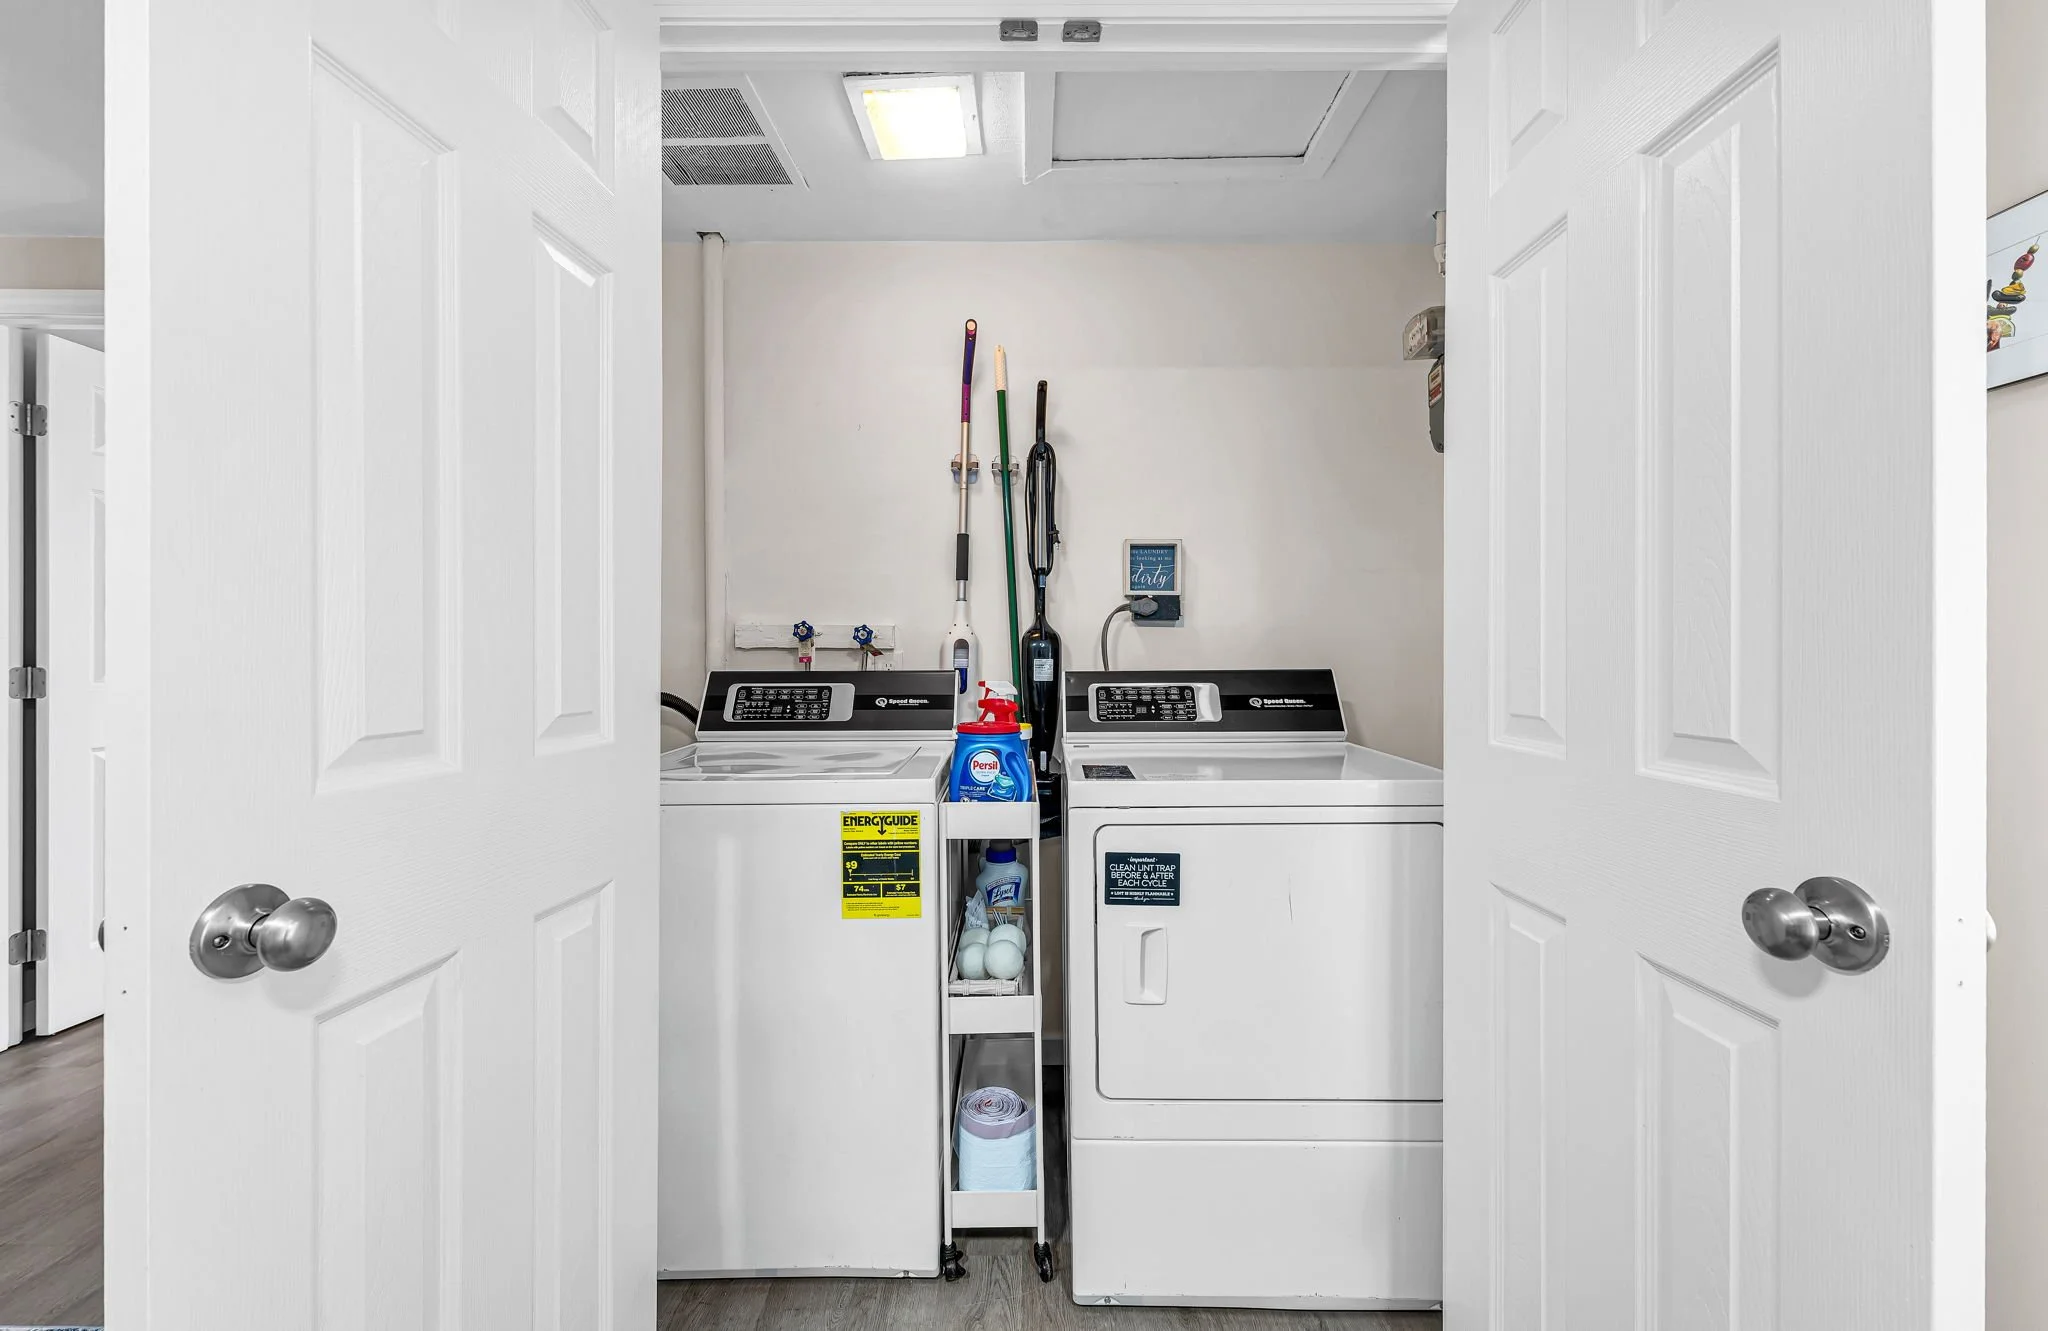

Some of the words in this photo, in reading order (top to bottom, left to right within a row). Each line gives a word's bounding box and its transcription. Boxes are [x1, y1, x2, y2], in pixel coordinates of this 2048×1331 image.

[1131, 563, 1172, 589] dirty
[973, 760, 998, 770] Persil
[843, 815, 918, 828] ENERGYGUIDE
[846, 860, 858, 869] $9
[1109, 863, 1136, 871] CLEAN
[1155, 864, 1176, 872] TRAP
[1111, 871, 1141, 879] BEFORE
[1150, 872, 1175, 880] AFTER
[1118, 879, 1140, 887] EACH
[993, 885, 1014, 899] Lysol
